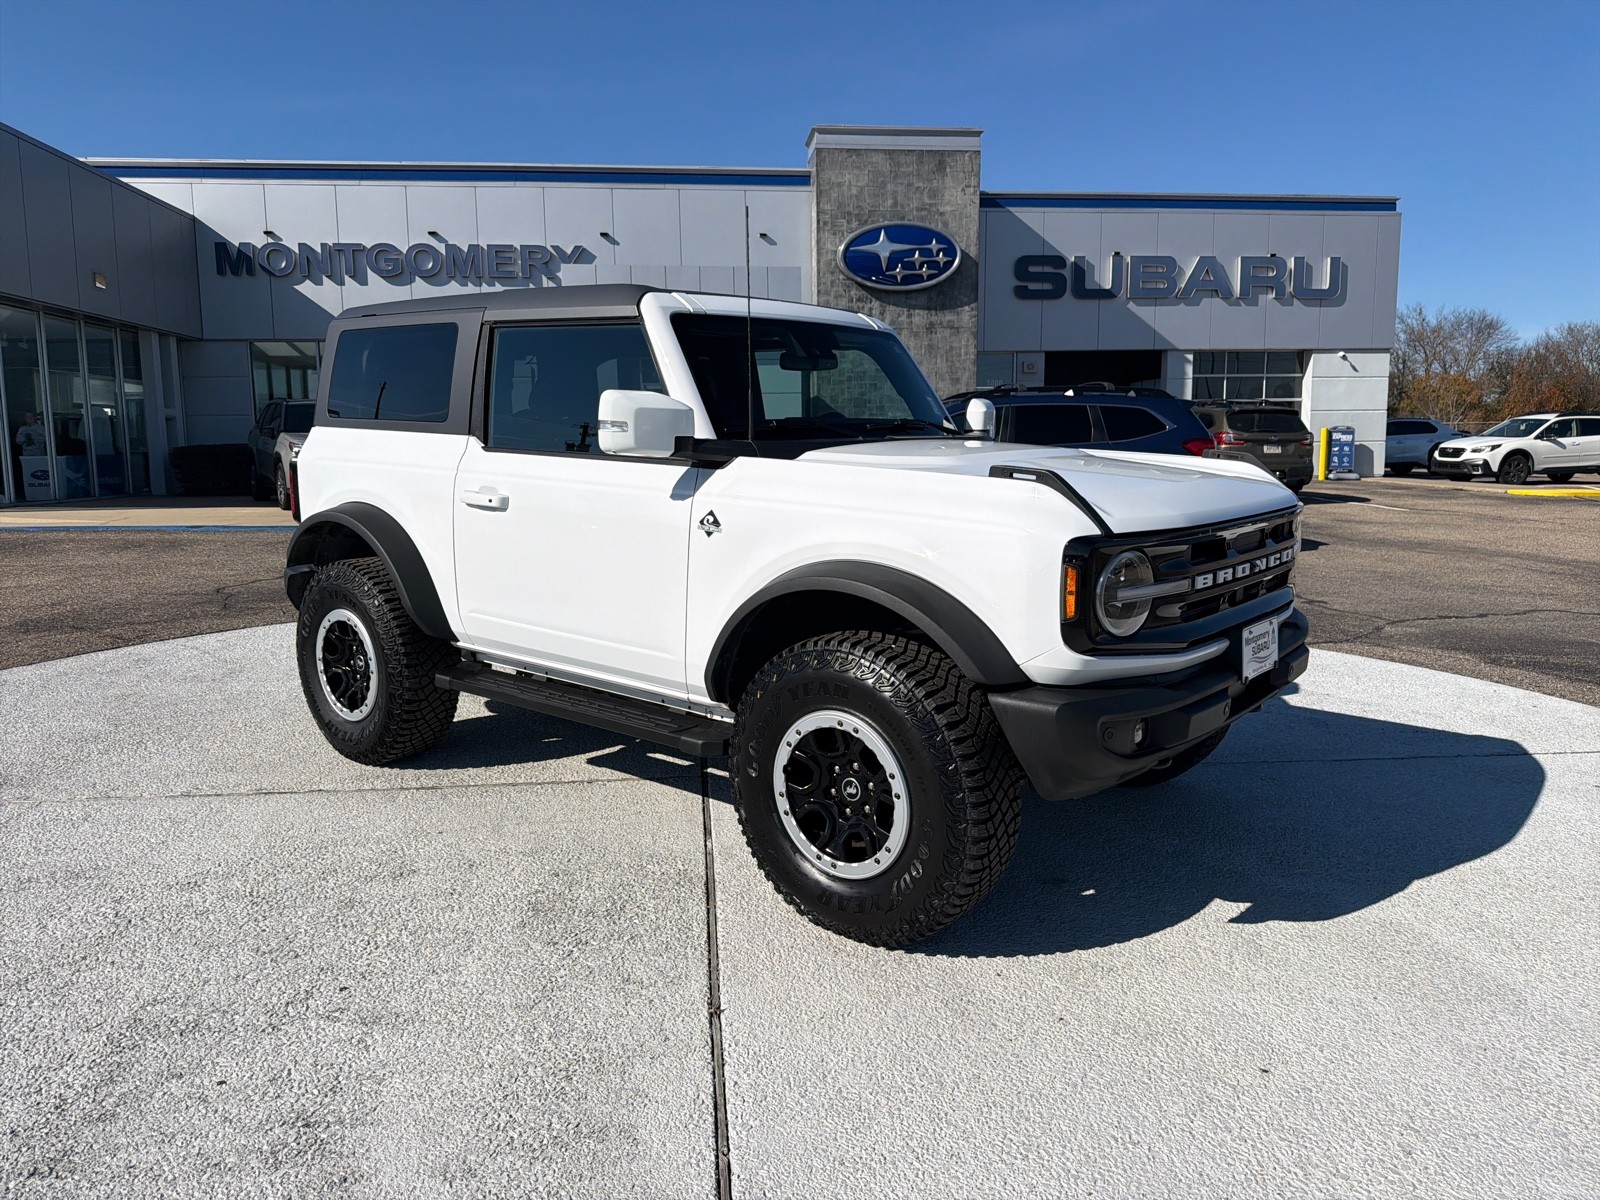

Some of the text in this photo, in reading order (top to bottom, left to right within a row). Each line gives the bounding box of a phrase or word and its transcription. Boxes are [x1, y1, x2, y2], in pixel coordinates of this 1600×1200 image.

[214, 241, 585, 279] MONTGOMERY
[1013, 254, 1342, 300] SUBARU
[1194, 547, 1294, 590] BRONCO
[1245, 629, 1270, 648] Montgomery
[1252, 640, 1271, 657] SUBARU
